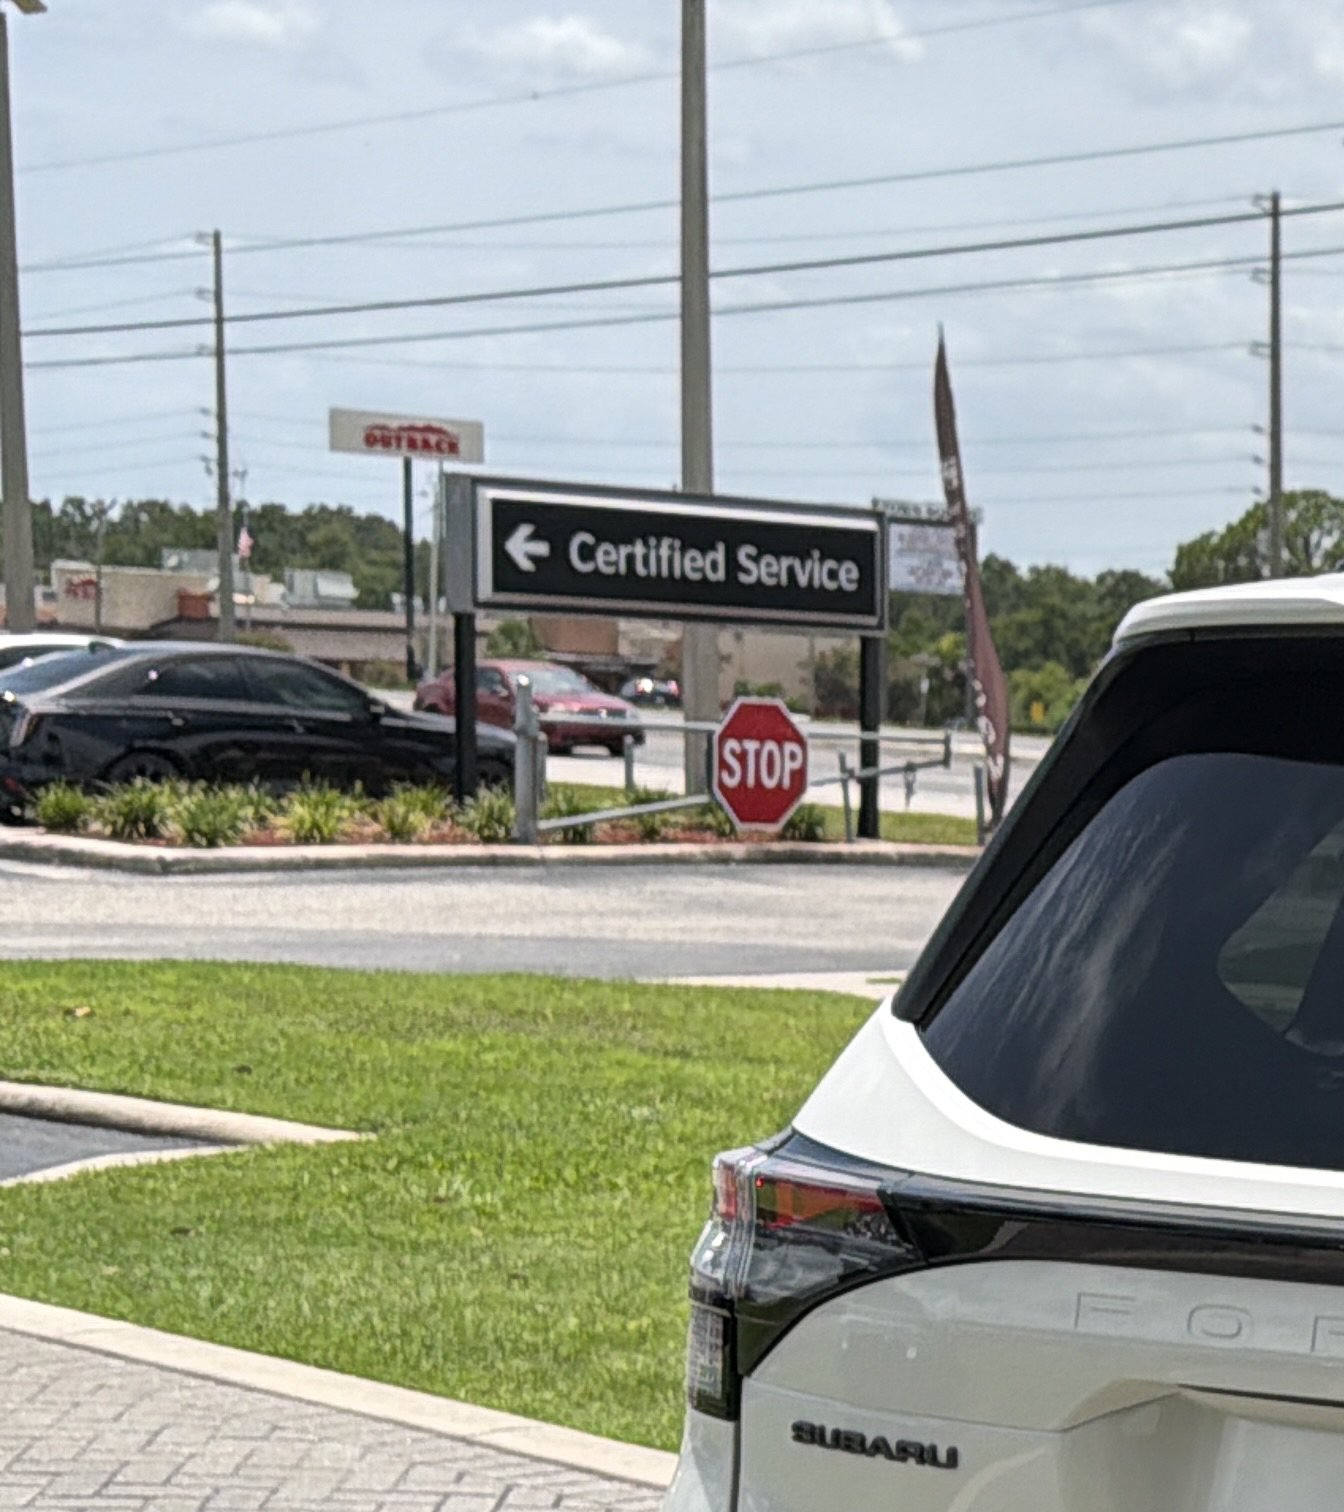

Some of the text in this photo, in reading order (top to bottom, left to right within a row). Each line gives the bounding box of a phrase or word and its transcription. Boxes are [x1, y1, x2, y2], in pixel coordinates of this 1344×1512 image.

[568, 530, 726, 583] Certified
[736, 543, 860, 593] Service
[721, 737, 803, 790] STOP
[791, 1419, 959, 1470] SUBARU
